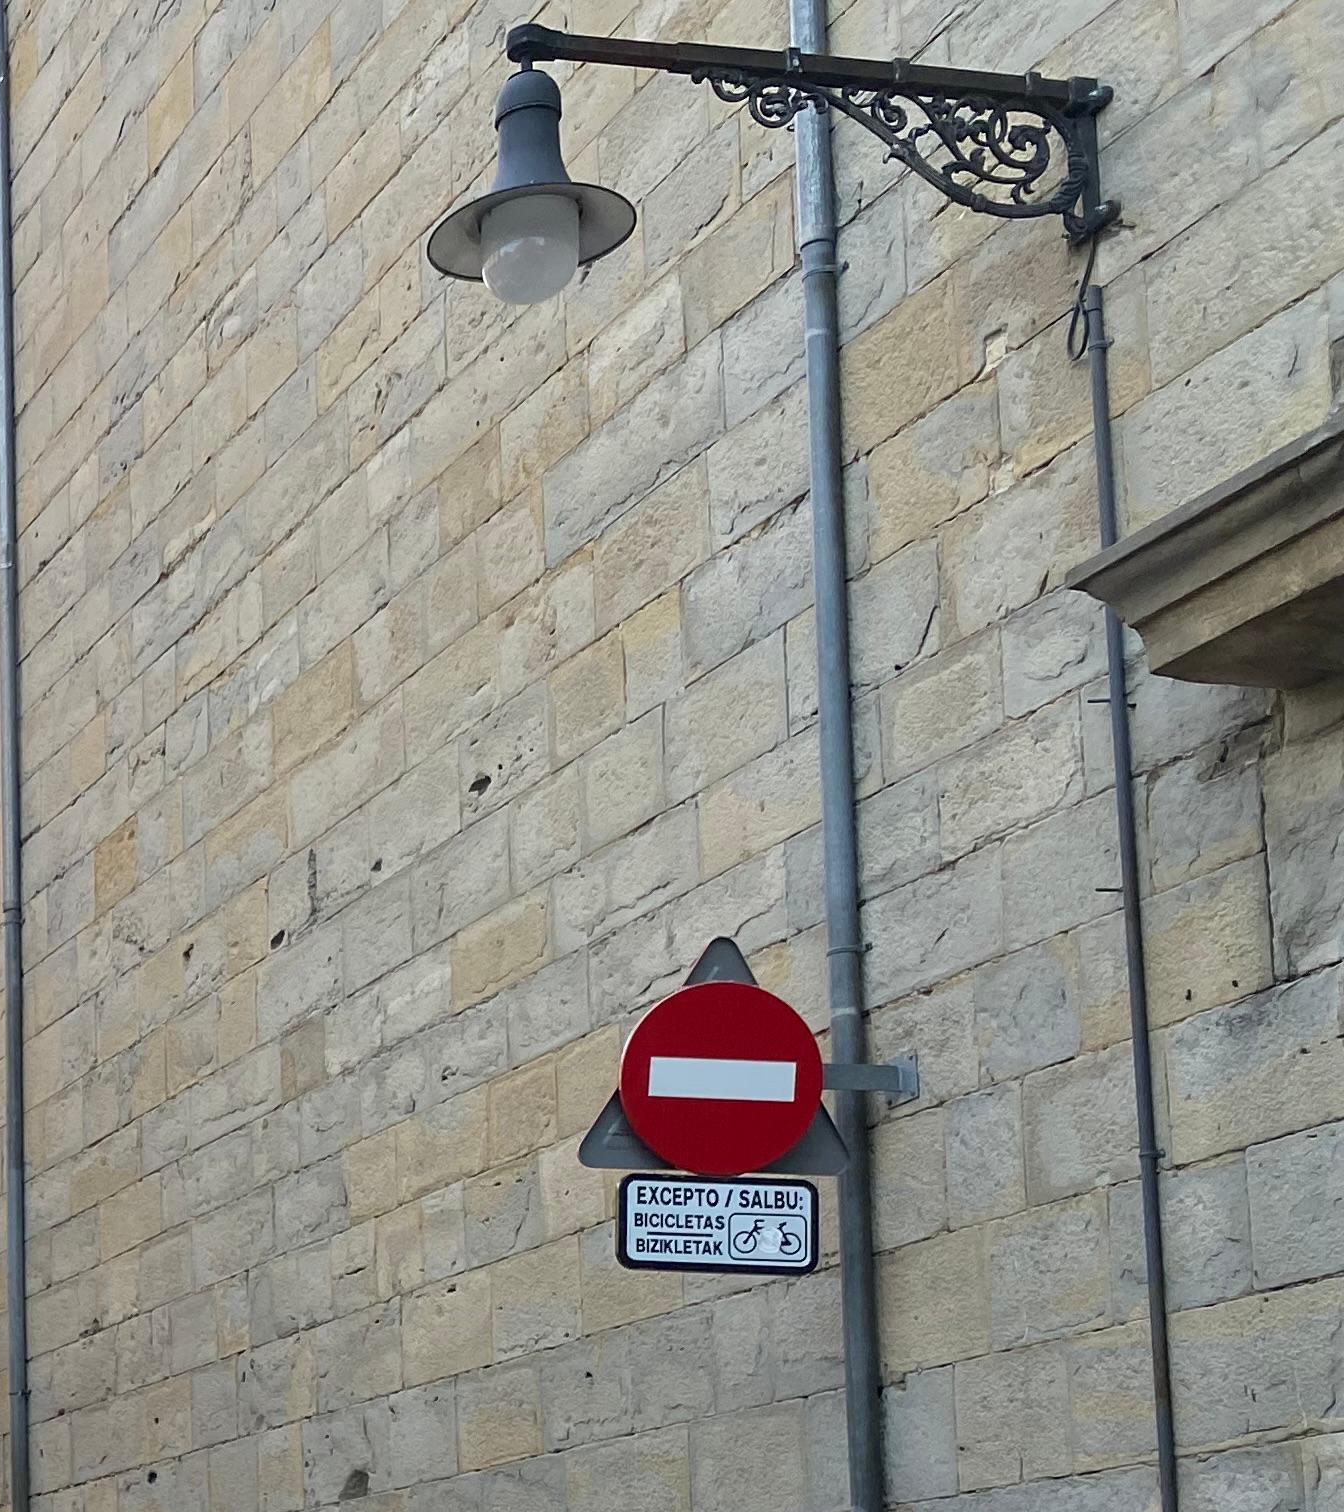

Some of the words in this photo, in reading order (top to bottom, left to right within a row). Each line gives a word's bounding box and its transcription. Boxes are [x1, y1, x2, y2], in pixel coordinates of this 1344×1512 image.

[636, 1186, 719, 1208] EXCEPTO
[725, 1189, 733, 1208] /
[739, 1190, 804, 1211] SALBU:
[634, 1213, 725, 1231] BICICLETAS
[635, 1238, 724, 1256] BIZIKLETAK
